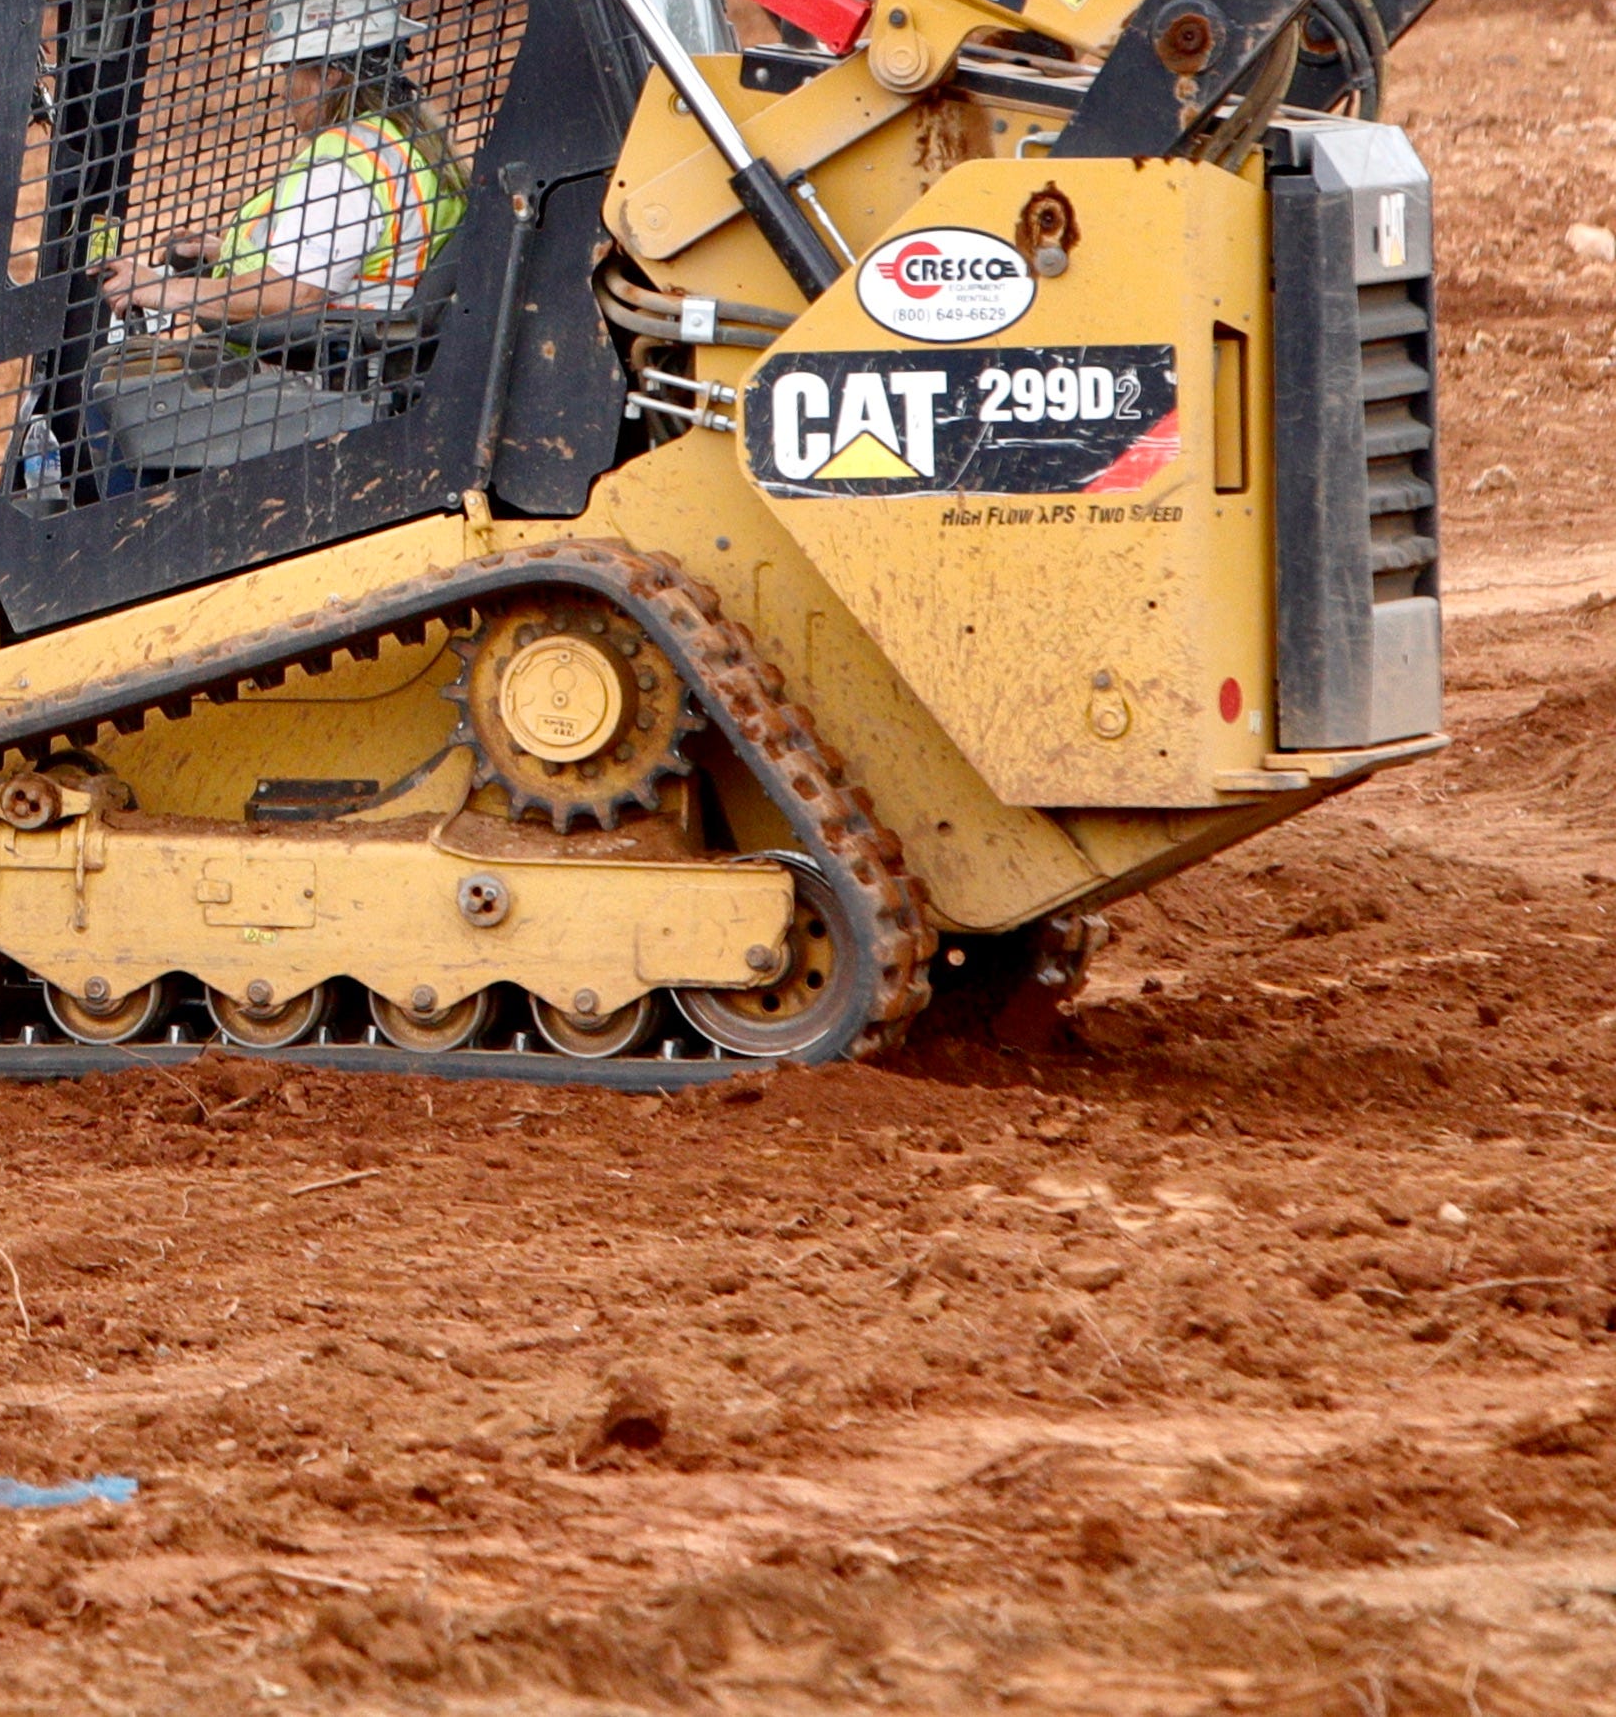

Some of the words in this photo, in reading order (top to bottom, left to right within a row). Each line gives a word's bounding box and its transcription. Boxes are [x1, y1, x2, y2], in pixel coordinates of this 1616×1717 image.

[905, 258, 1013, 281] CRESCO
[892, 307, 931, 323] (800)
[936, 307, 1007, 322] 649-6629
[772, 371, 948, 480] CAT
